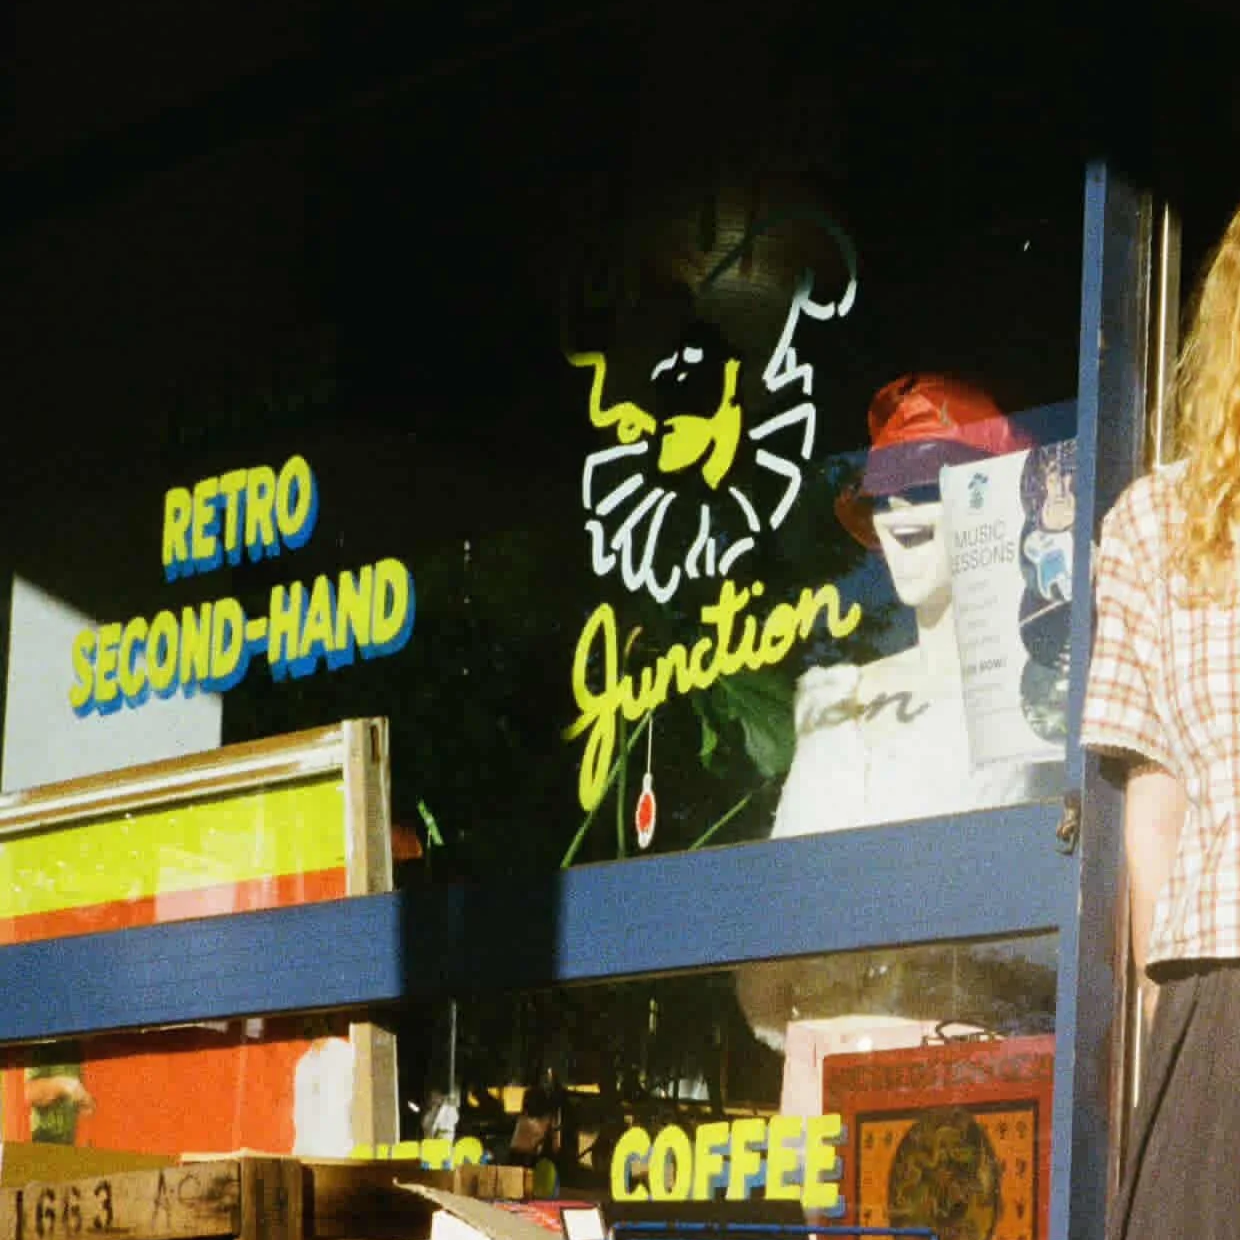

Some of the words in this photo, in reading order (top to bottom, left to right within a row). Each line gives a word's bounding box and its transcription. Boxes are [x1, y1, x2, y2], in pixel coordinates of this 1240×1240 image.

[162, 456, 315, 575] RETRO
[954, 517, 1006, 548] MUSIC
[69, 557, 412, 713] SECOND-HAND
[565, 581, 862, 811] Junction
[611, 1110, 847, 1213] COFFEE
